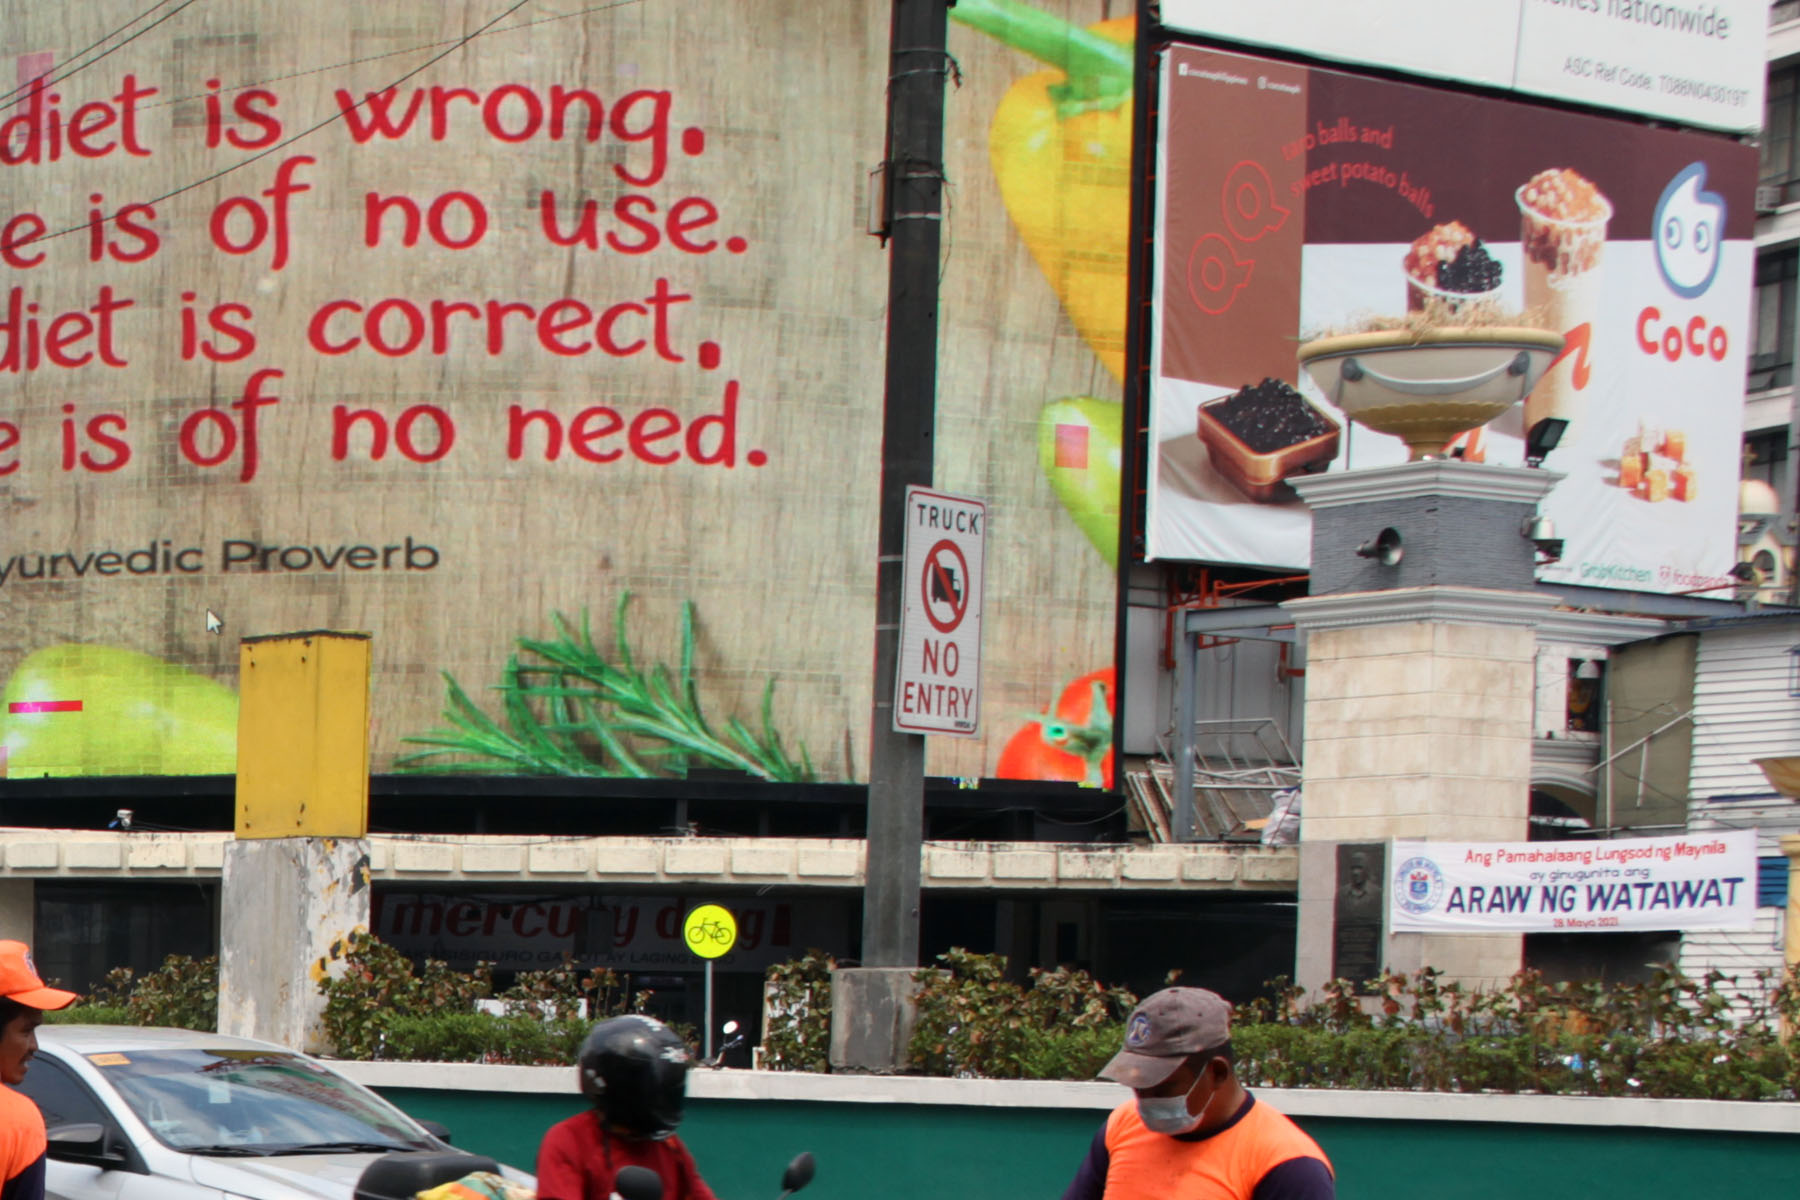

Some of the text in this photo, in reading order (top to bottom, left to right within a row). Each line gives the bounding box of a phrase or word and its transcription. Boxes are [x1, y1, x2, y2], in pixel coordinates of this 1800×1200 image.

[1607, 0, 1729, 39] nationwide
[1563, 56, 1592, 78] ASC
[1594, 62, 1617, 83] Ref
[206, 80, 283, 151] is
[1281, 116, 1395, 161] taro balls and
[1290, 162, 1435, 218] sweet potato balls
[90, 193, 161, 264] is
[209, 156, 317, 271] of
[364, 191, 489, 251] no
[540, 190, 748, 255] use.
[181, 291, 257, 364] is
[62, 402, 132, 474] is
[178, 368, 285, 484] of
[331, 405, 456, 464] no
[507, 381, 768, 469] need.
[917, 503, 980, 535] TRUCK
[221, 537, 439, 573] Proverb
[922, 638, 959, 678] NO
[903, 681, 974, 719] ENTRY
[1464, 840, 1726, 868] Ang Pamahalaang Lungsod ng Maynila
[1529, 867, 1650, 883] ay ginugunita ang
[1446, 885, 1532, 913] ARAW
[1540, 884, 1577, 913] NG
[1586, 877, 1745, 912] WATAWAT
[392, 895, 641, 948] mercuy
[1553, 917, 1619, 928] 28 Mayo 2021
